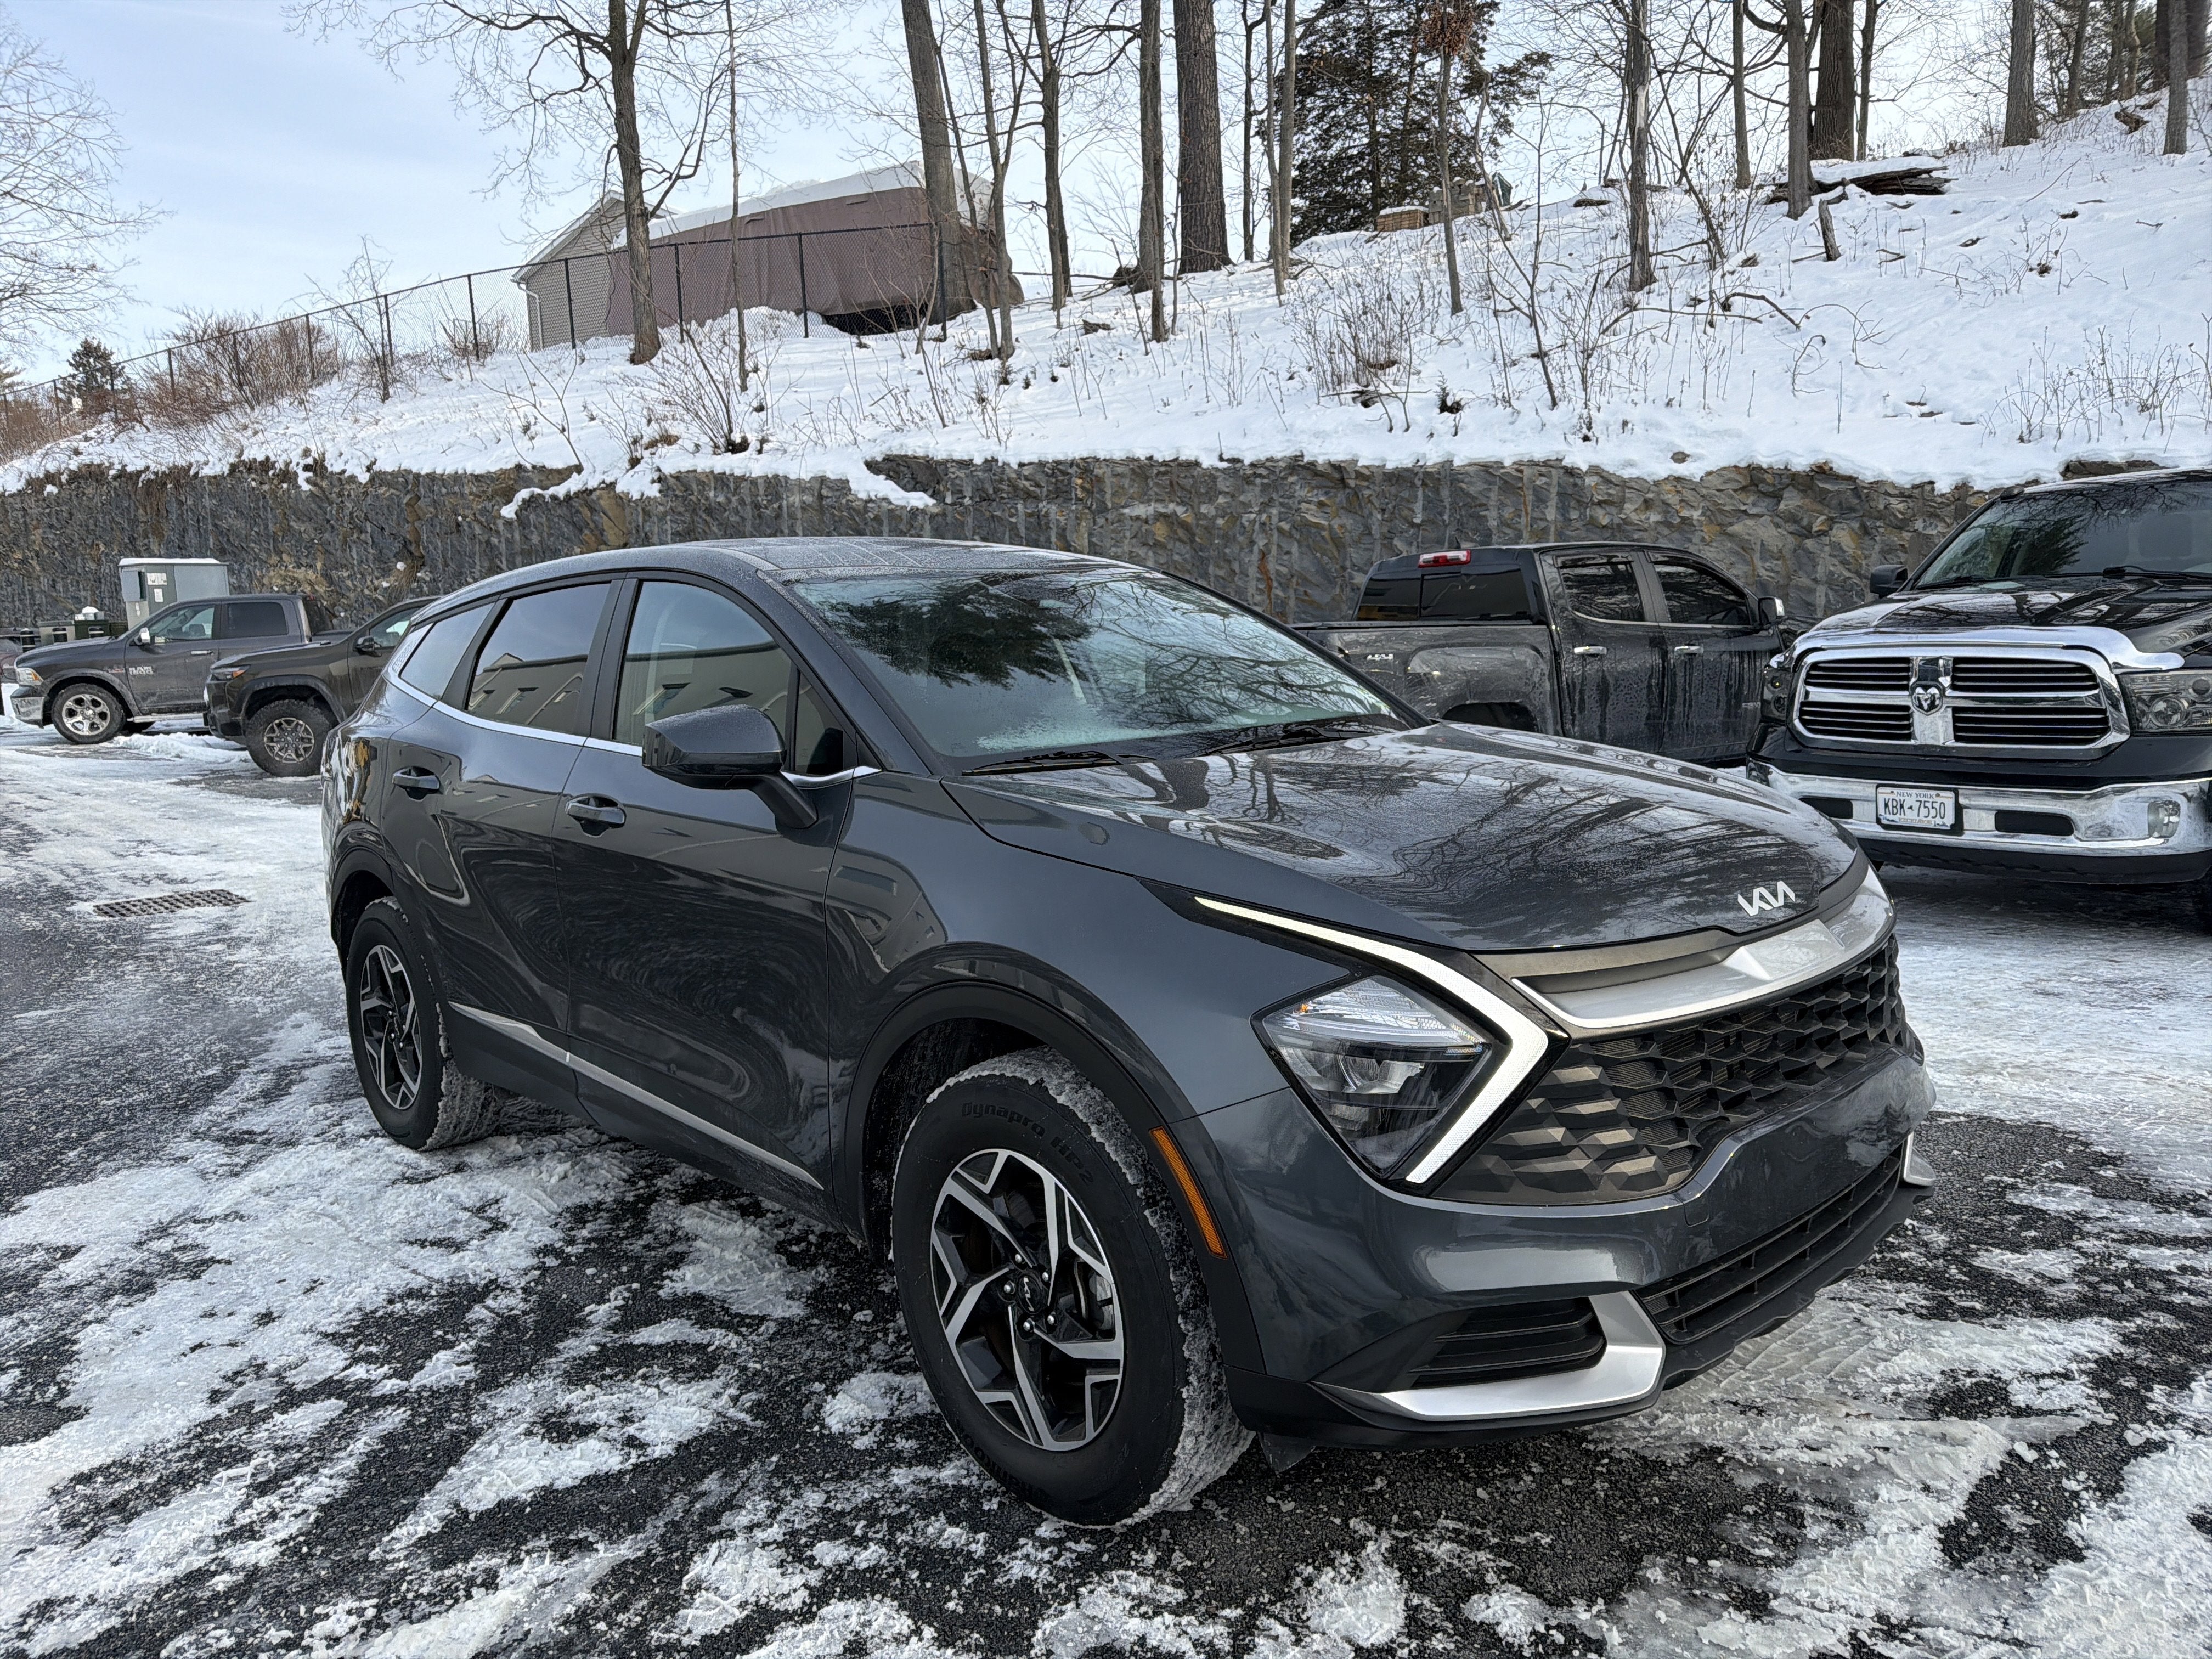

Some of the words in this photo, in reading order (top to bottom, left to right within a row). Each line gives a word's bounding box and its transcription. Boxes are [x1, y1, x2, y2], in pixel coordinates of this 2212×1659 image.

[1884, 798, 1906, 816] KBK
[1915, 799, 1946, 819] 7550
[1737, 881, 1796, 916] KIA
